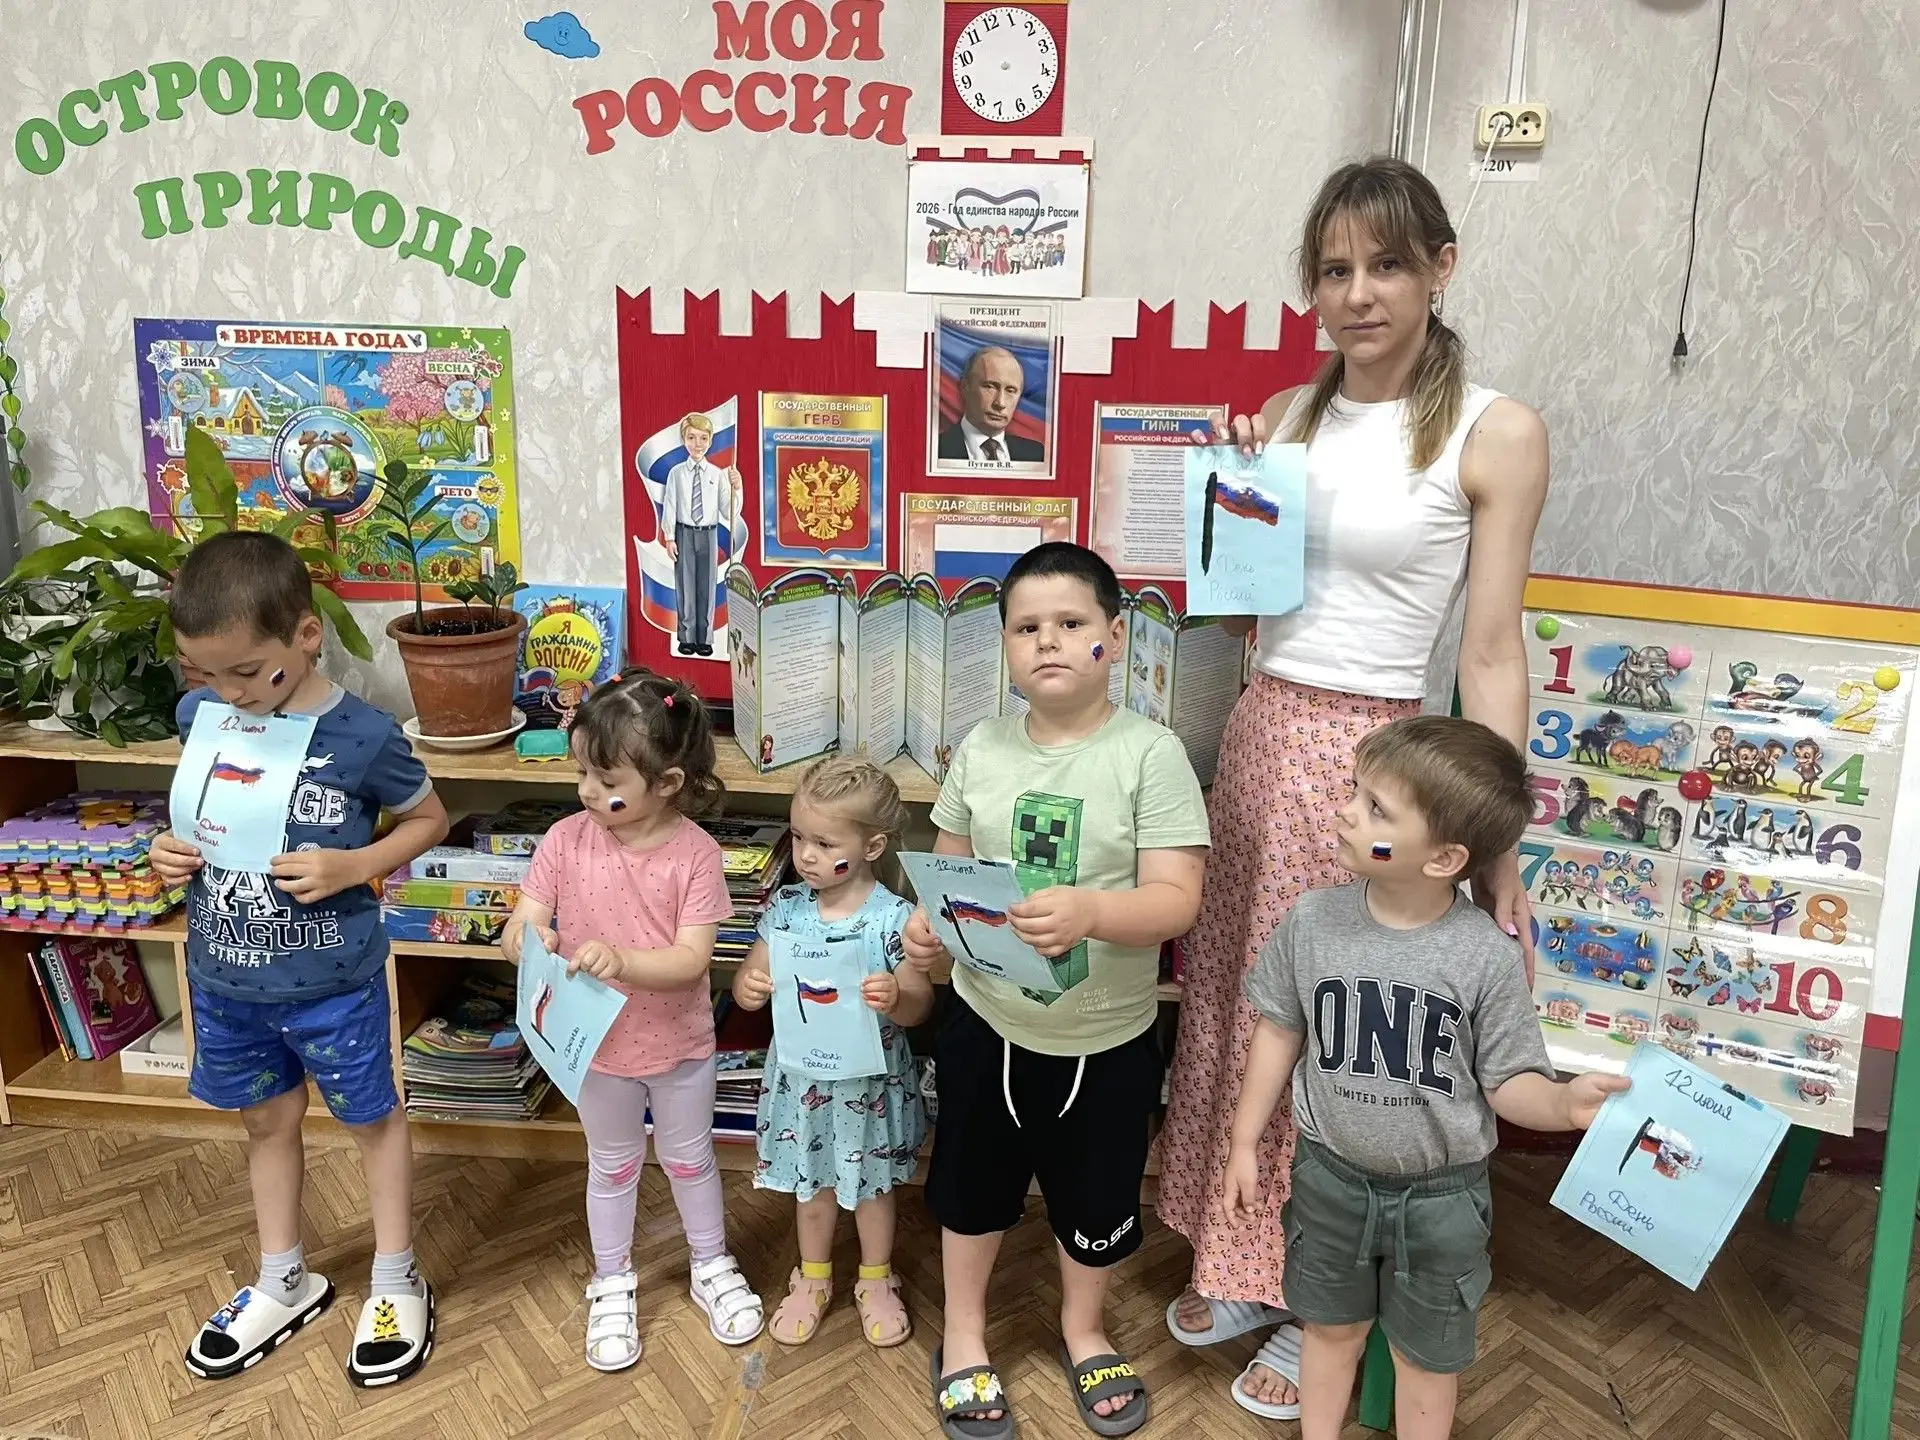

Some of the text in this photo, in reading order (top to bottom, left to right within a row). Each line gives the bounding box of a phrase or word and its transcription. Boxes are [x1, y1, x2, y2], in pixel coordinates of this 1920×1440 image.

[982, 14, 1000, 32] 12
[1007, 13, 1016, 27] 1
[712, 0, 886, 62] МОЯ
[966, 29, 982, 46] 11
[1024, 21, 1036, 37] 2
[1038, 39, 1049, 53] 3
[958, 50, 974, 67] 10
[1041, 63, 1051, 77] 4
[961, 75, 972, 89] 9
[974, 93, 986, 107] 8
[1032, 84, 1042, 99] 5
[572, 69, 913, 155] РОССИЯ
[993, 101, 1002, 116] 7
[1015, 98, 1026, 112] 6
[15, 56, 409, 175] ОСТРОВОК
[916, 203, 939, 214] 2026
[948, 203, 964, 216] Год
[966, 207, 1007, 216] единства
[1009, 207, 1045, 218] народов
[1047, 206, 1079, 218] России
[133, 169, 526, 299] ПРИРОДЫ
[969, 307, 1021, 316] ПРЕЗИДЕНТ
[1000, 321, 1047, 329] ФЕДЕРАЦИИ
[234, 328, 408, 350] ВРЕМЕНА ГОДА
[181, 357, 216, 368] ЗИМА
[428, 362, 471, 374] ВЕСНА
[773, 400, 871, 411] ГОСУДАРСТВЕННЫЙ
[1115, 409, 1208, 418] ГОСУДАРСТВЕННЫЙ
[804, 414, 841, 426] ГЕРБ
[1142, 420, 1179, 432] ГИМН
[1114, 435, 1161, 443] РОССИЙСКОЙ
[440, 487, 472, 497] ЛЕТО
[912, 500, 1067, 514] ГОСУДАРСТВЕННЫЙ ФЛАГ
[559, 620, 571, 634] Я
[531, 634, 598, 653] ГРАЖДАНИН
[534, 646, 593, 674] РОССИИ
[1543, 645, 1576, 695] 1
[1831, 680, 1878, 735] 2
[218, 715, 240, 730] 12
[1529, 710, 1573, 760] 3
[1821, 753, 1869, 806] 4
[286, 780, 347, 826] GE
[1526, 774, 1561, 825] 5
[1815, 823, 1862, 872] 6
[1518, 842, 1555, 891] 7
[1800, 893, 1848, 945] 8
[208, 943, 273, 965] STREET
[1763, 961, 1843, 1022] 10
[1312, 976, 1464, 1099] ONE
[1664, 1069, 1694, 1098] 12
[1333, 1084, 1430, 1107] LIMITED EDITION
[1608, 1190, 1655, 1231] День
[1074, 1215, 1135, 1251] BOSS
